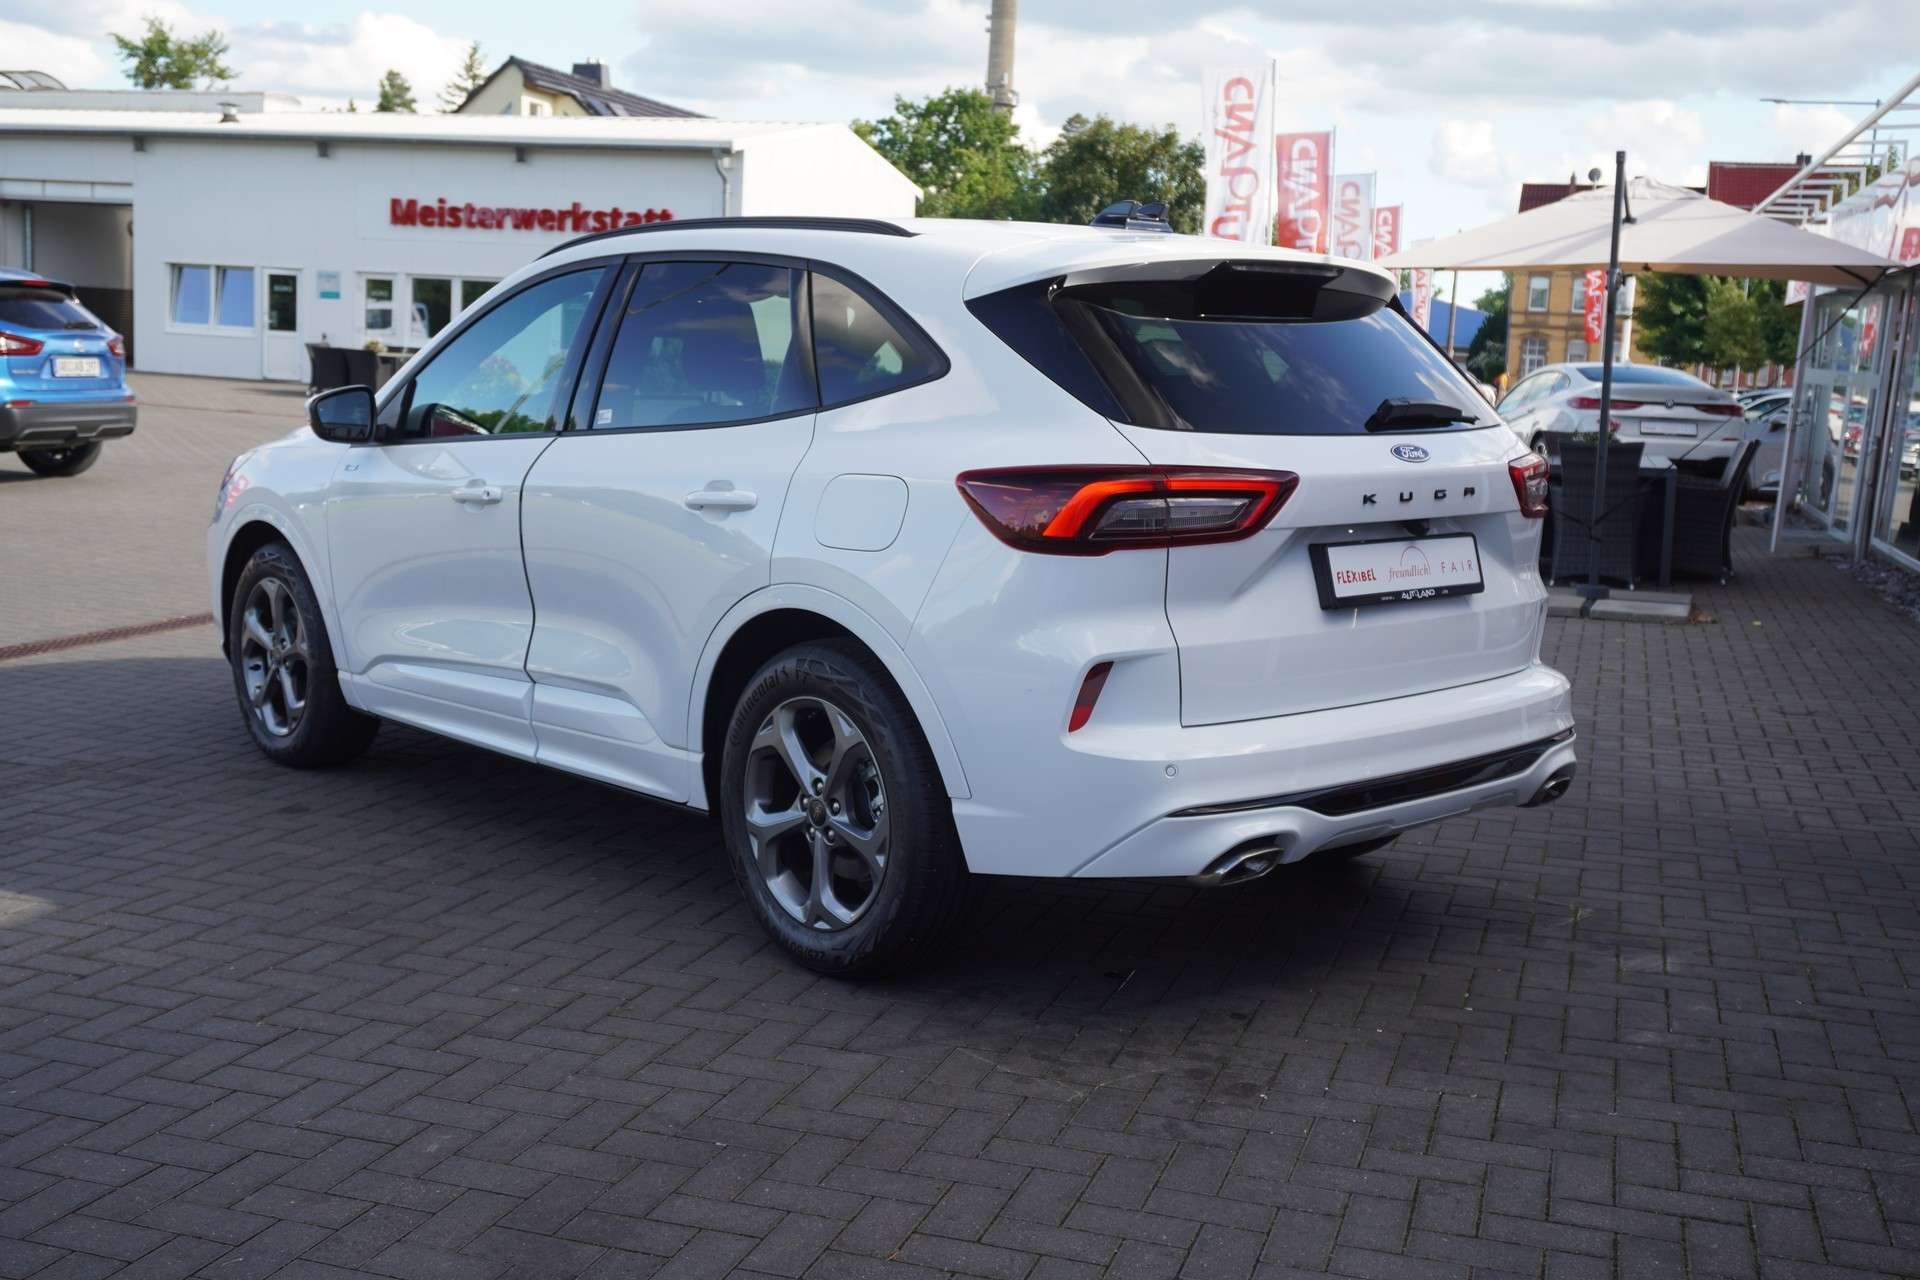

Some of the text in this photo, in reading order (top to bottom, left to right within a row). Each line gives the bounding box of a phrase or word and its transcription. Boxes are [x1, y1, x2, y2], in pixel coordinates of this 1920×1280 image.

[1363, 486, 1476, 505] KUGA
[1336, 567, 1377, 584] FLEXIBEL
[1440, 559, 1474, 575] FAIR
